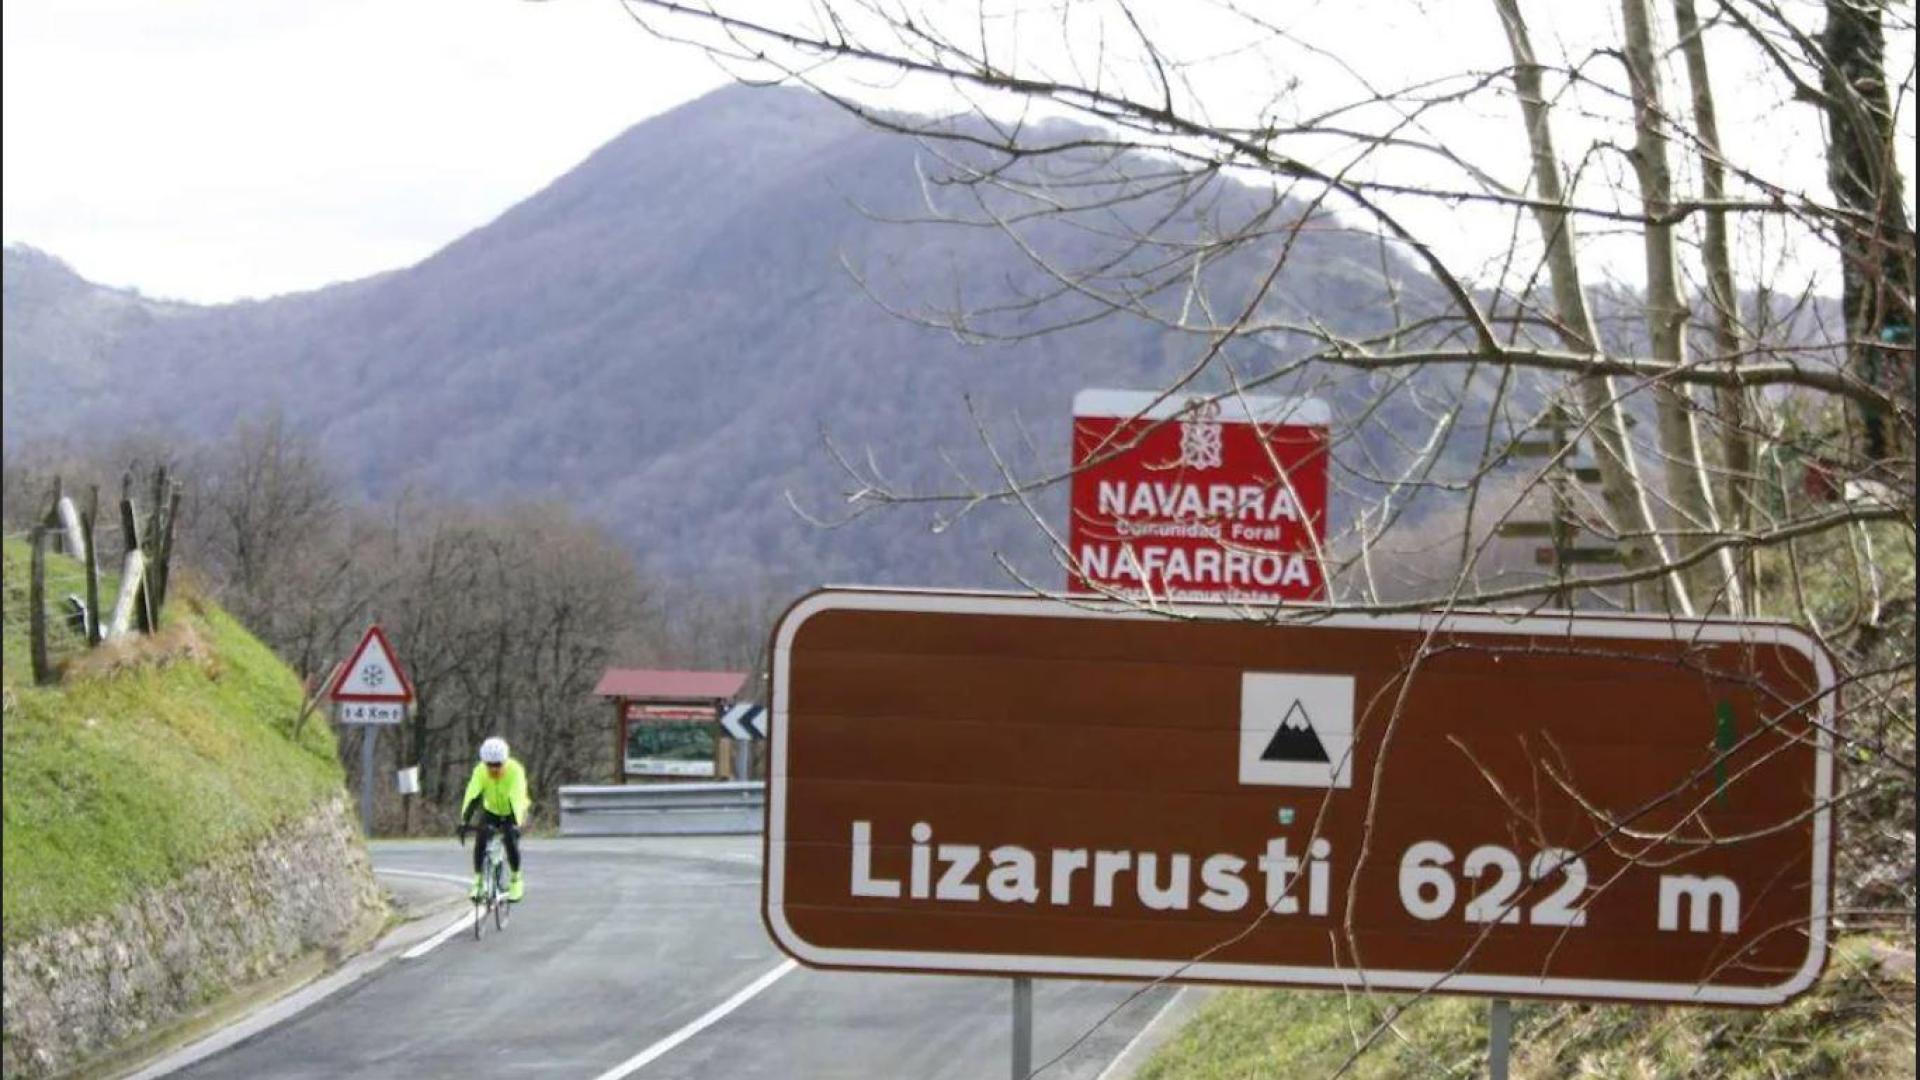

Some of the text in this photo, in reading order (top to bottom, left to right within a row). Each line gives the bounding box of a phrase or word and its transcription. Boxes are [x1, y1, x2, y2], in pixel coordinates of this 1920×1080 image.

[1099, 481, 1297, 521] NAVARRA
[1116, 521, 1281, 541] Comunidad Foral
[1080, 544, 1310, 586] NAFARROA
[851, 820, 1740, 933] Lizarrusti 622 m
